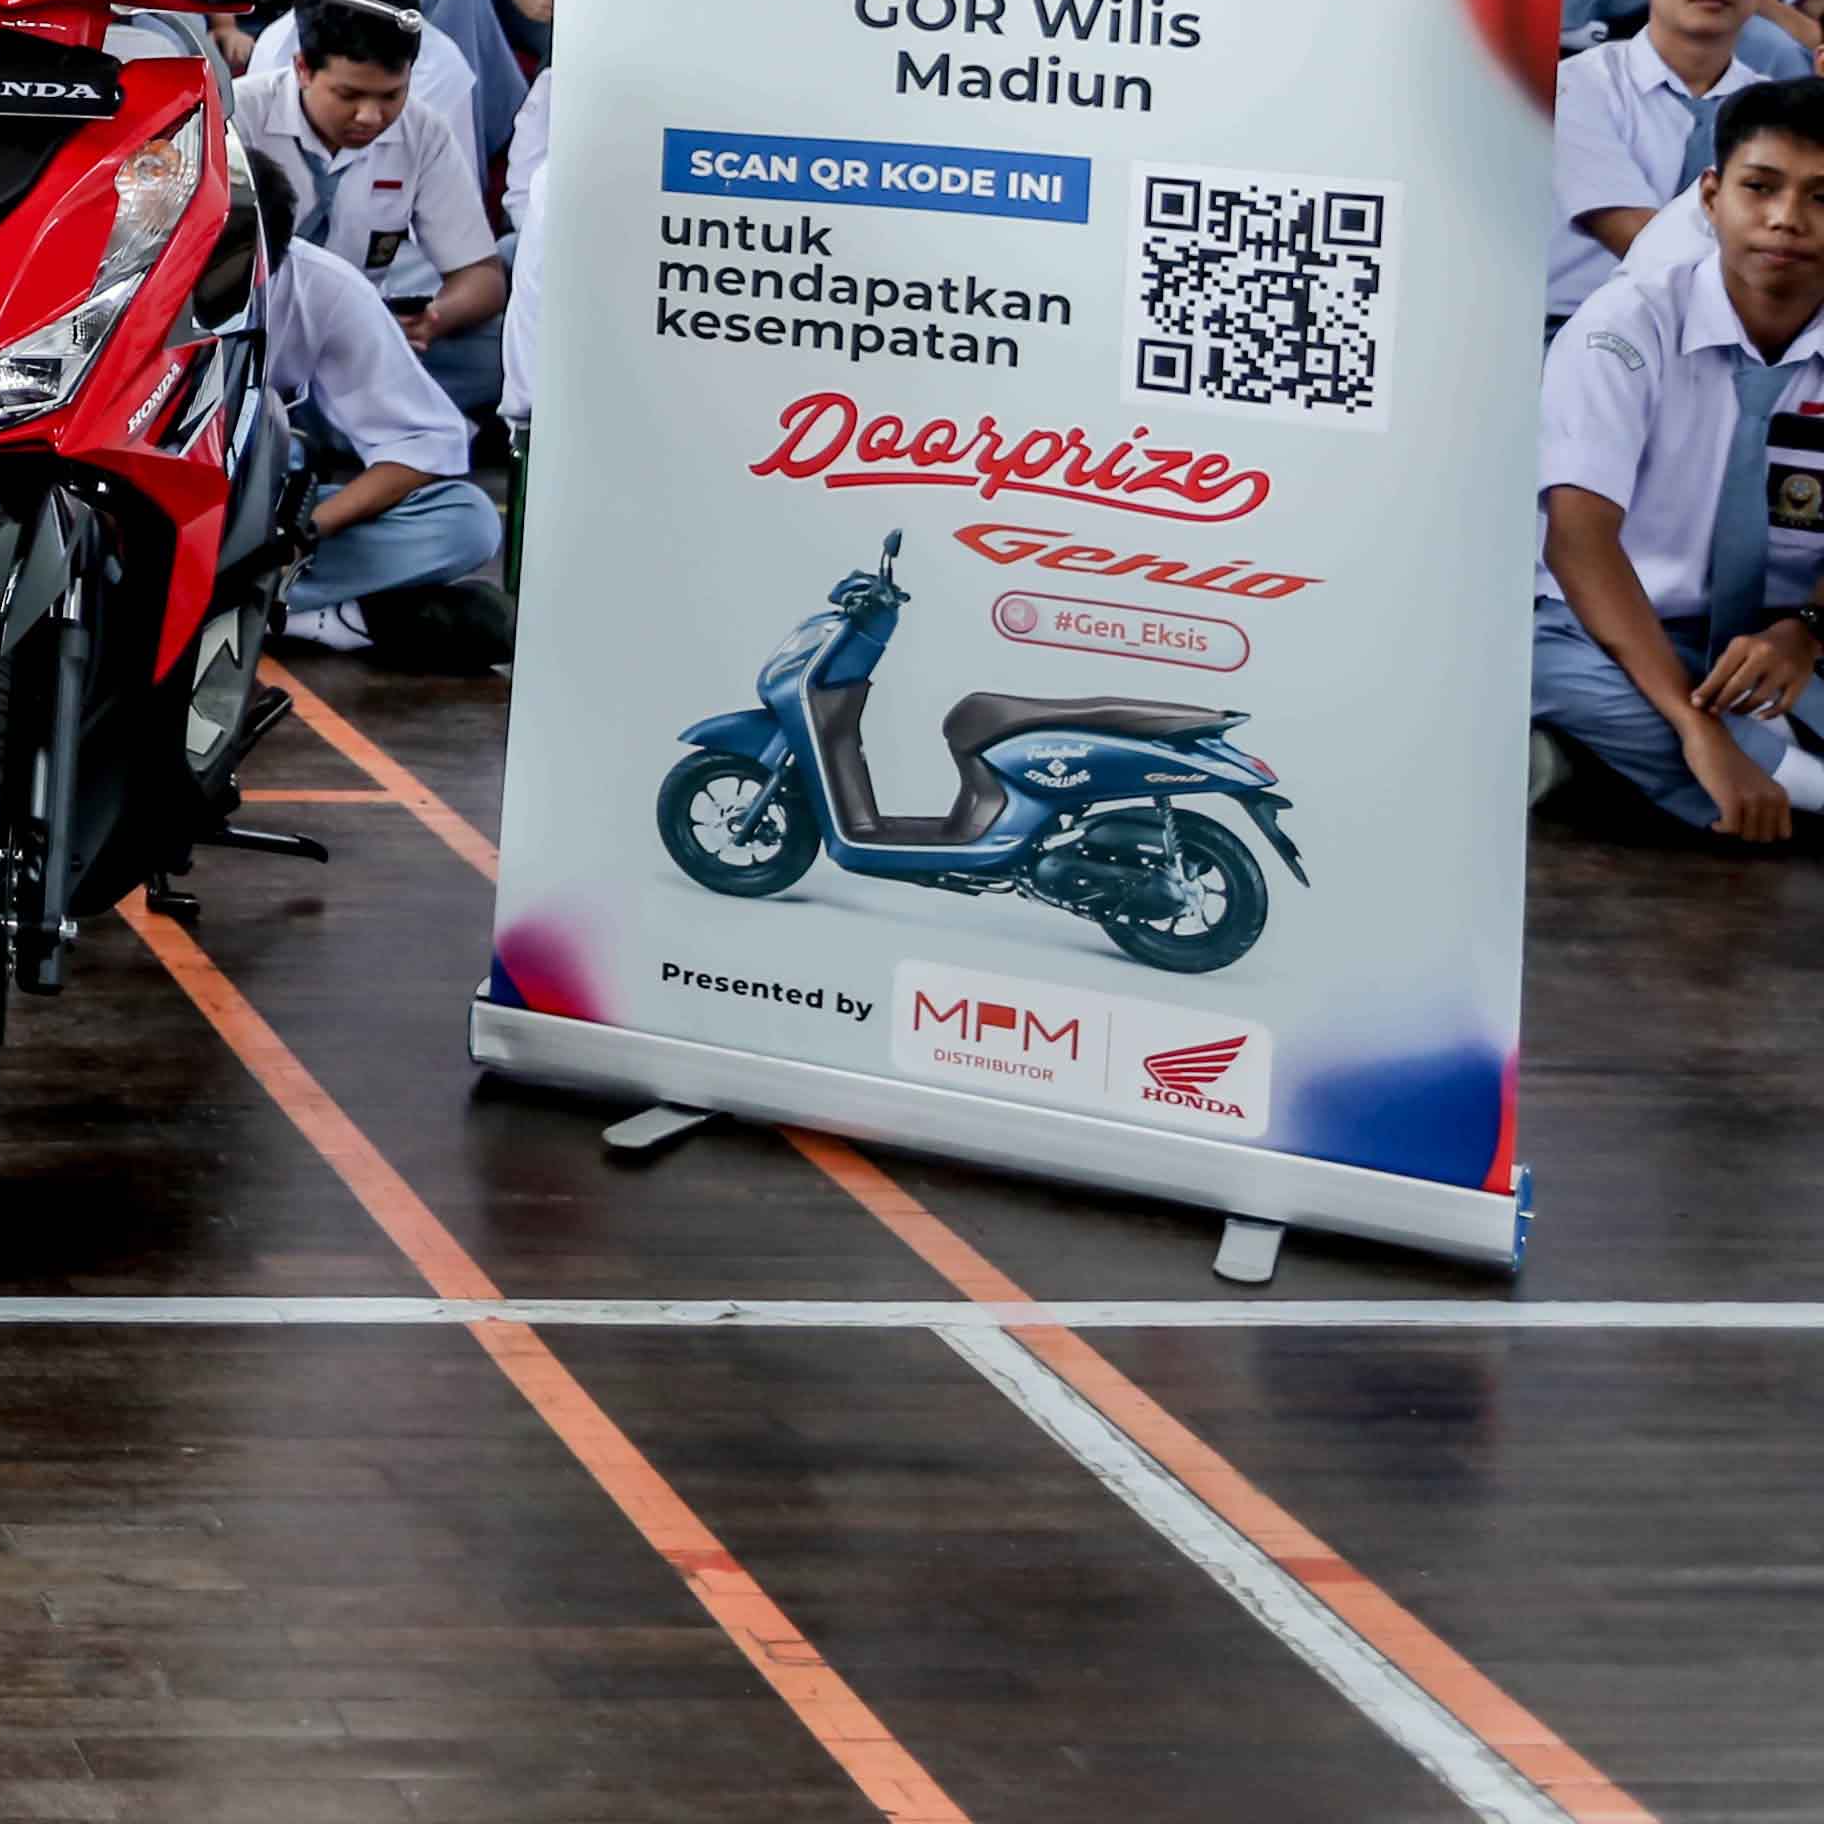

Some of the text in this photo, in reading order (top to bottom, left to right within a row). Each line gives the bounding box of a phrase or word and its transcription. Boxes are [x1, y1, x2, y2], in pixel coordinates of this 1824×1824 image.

[895, 50, 1154, 112] Madiun
[689, 149, 1063, 204] SCAN QR KODE INI
[660, 211, 833, 257] untuk
[658, 259, 1072, 326] mendapatkan
[655, 296, 1020, 368] kesempatan
[128, 362, 181, 434] HONDA
[749, 392, 1271, 518] Doorprize
[952, 523, 1325, 599] Genio
[1053, 610, 1209, 653] #Gen_Eksis
[661, 962, 875, 1023] Presented by
[913, 990, 1080, 1062] MPM
[933, 1048, 1056, 1082] DISTRIBUTOR
[1141, 1084, 1247, 1120] HONDA
